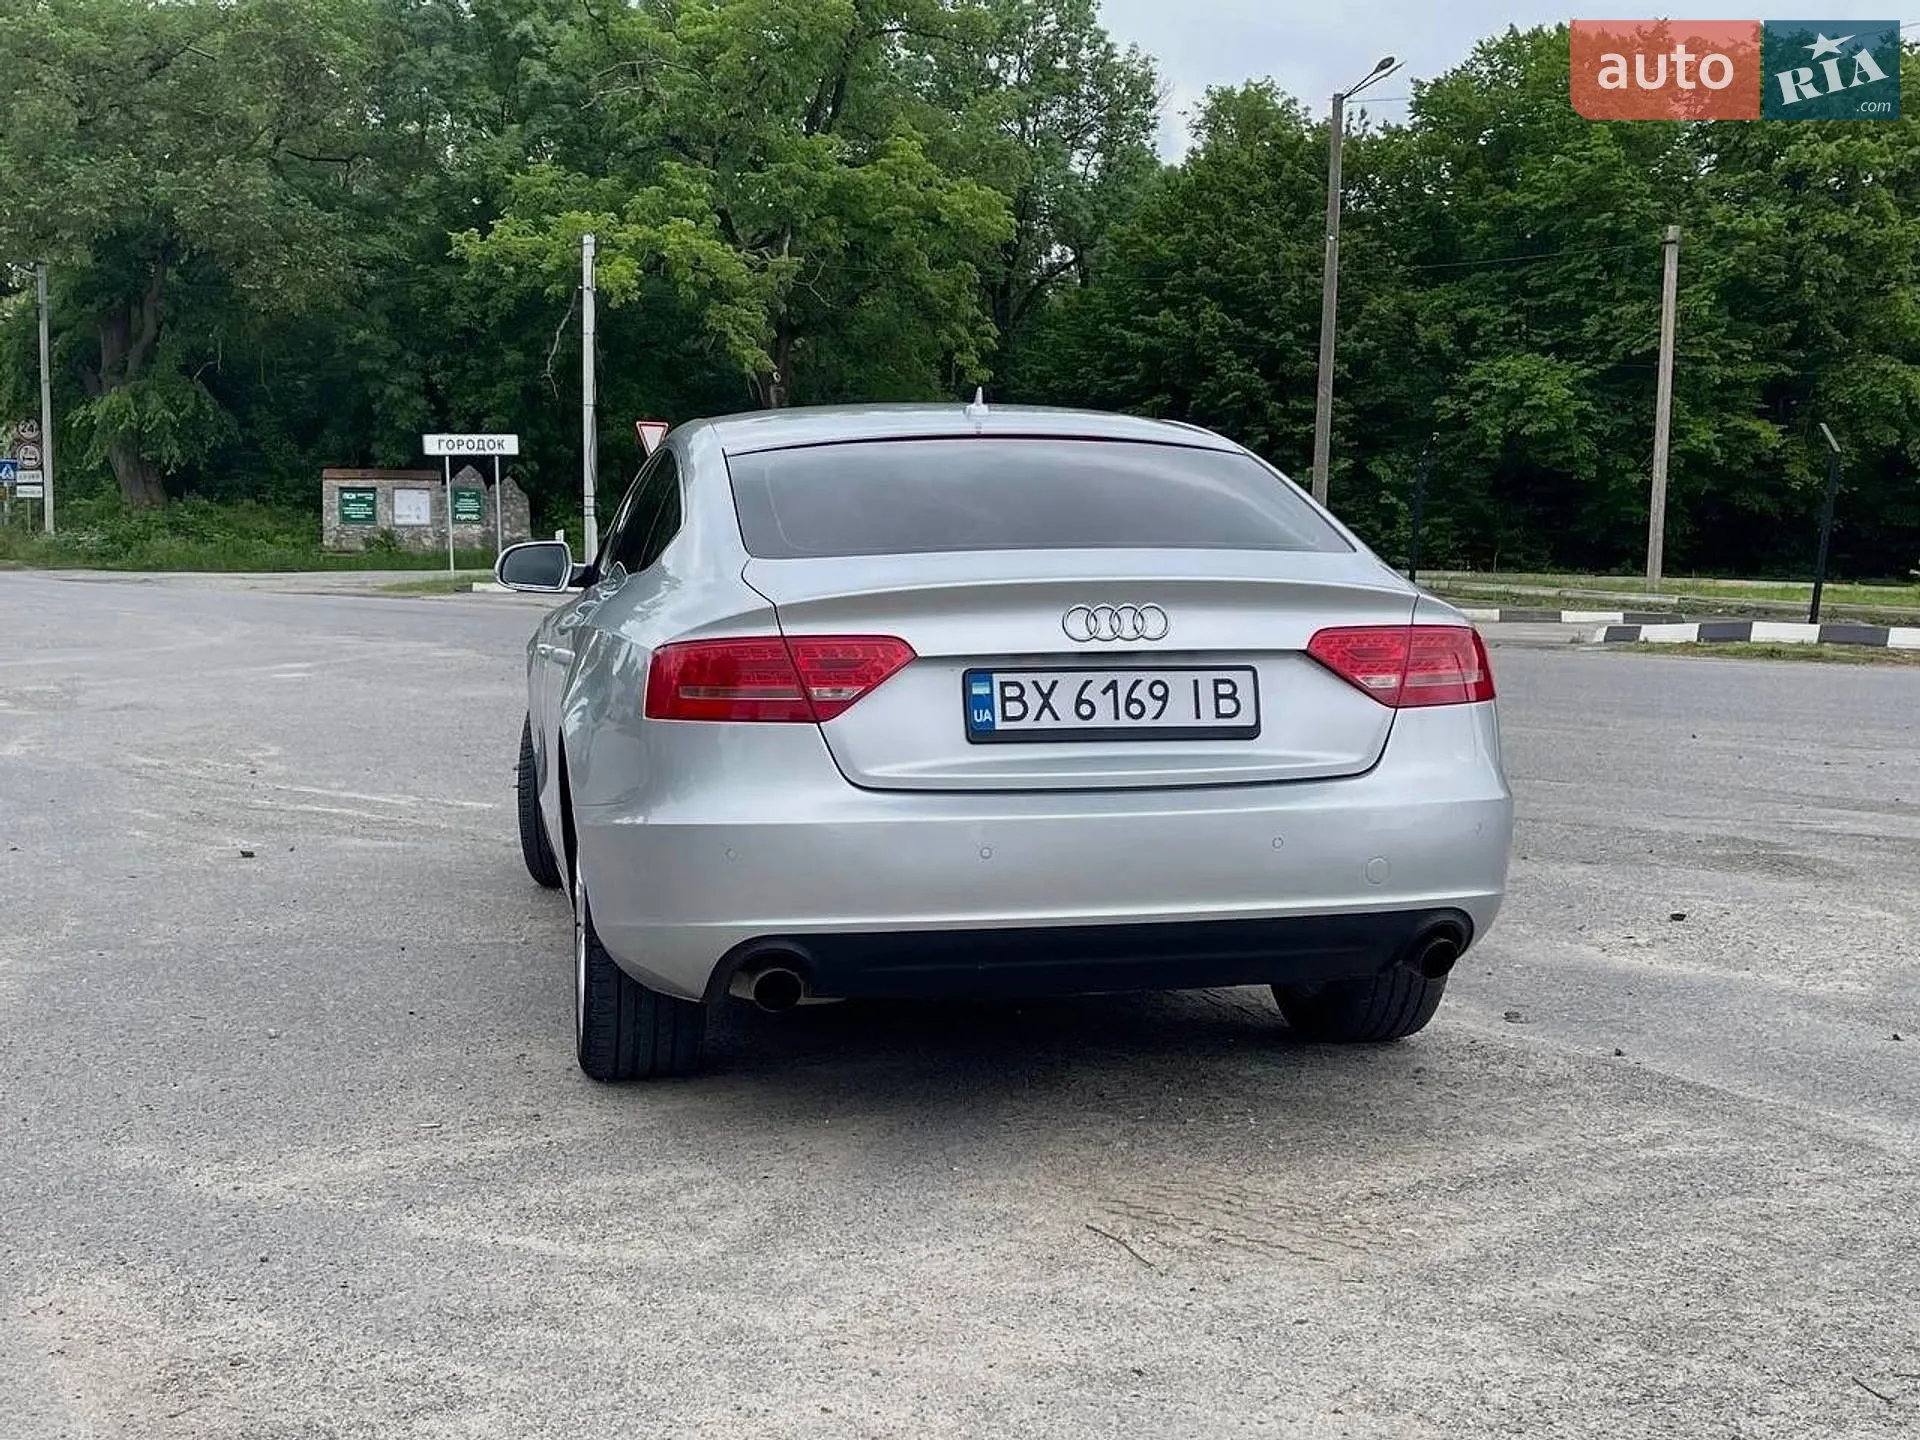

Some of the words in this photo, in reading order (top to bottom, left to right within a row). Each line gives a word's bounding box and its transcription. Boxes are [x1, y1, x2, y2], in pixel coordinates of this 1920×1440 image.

[438, 438, 505, 451] ГОРОДОК
[999, 679, 1061, 722] BX
[1074, 679, 1170, 721] 6169
[1193, 678, 1242, 720] IB
[973, 709, 993, 722] UA
